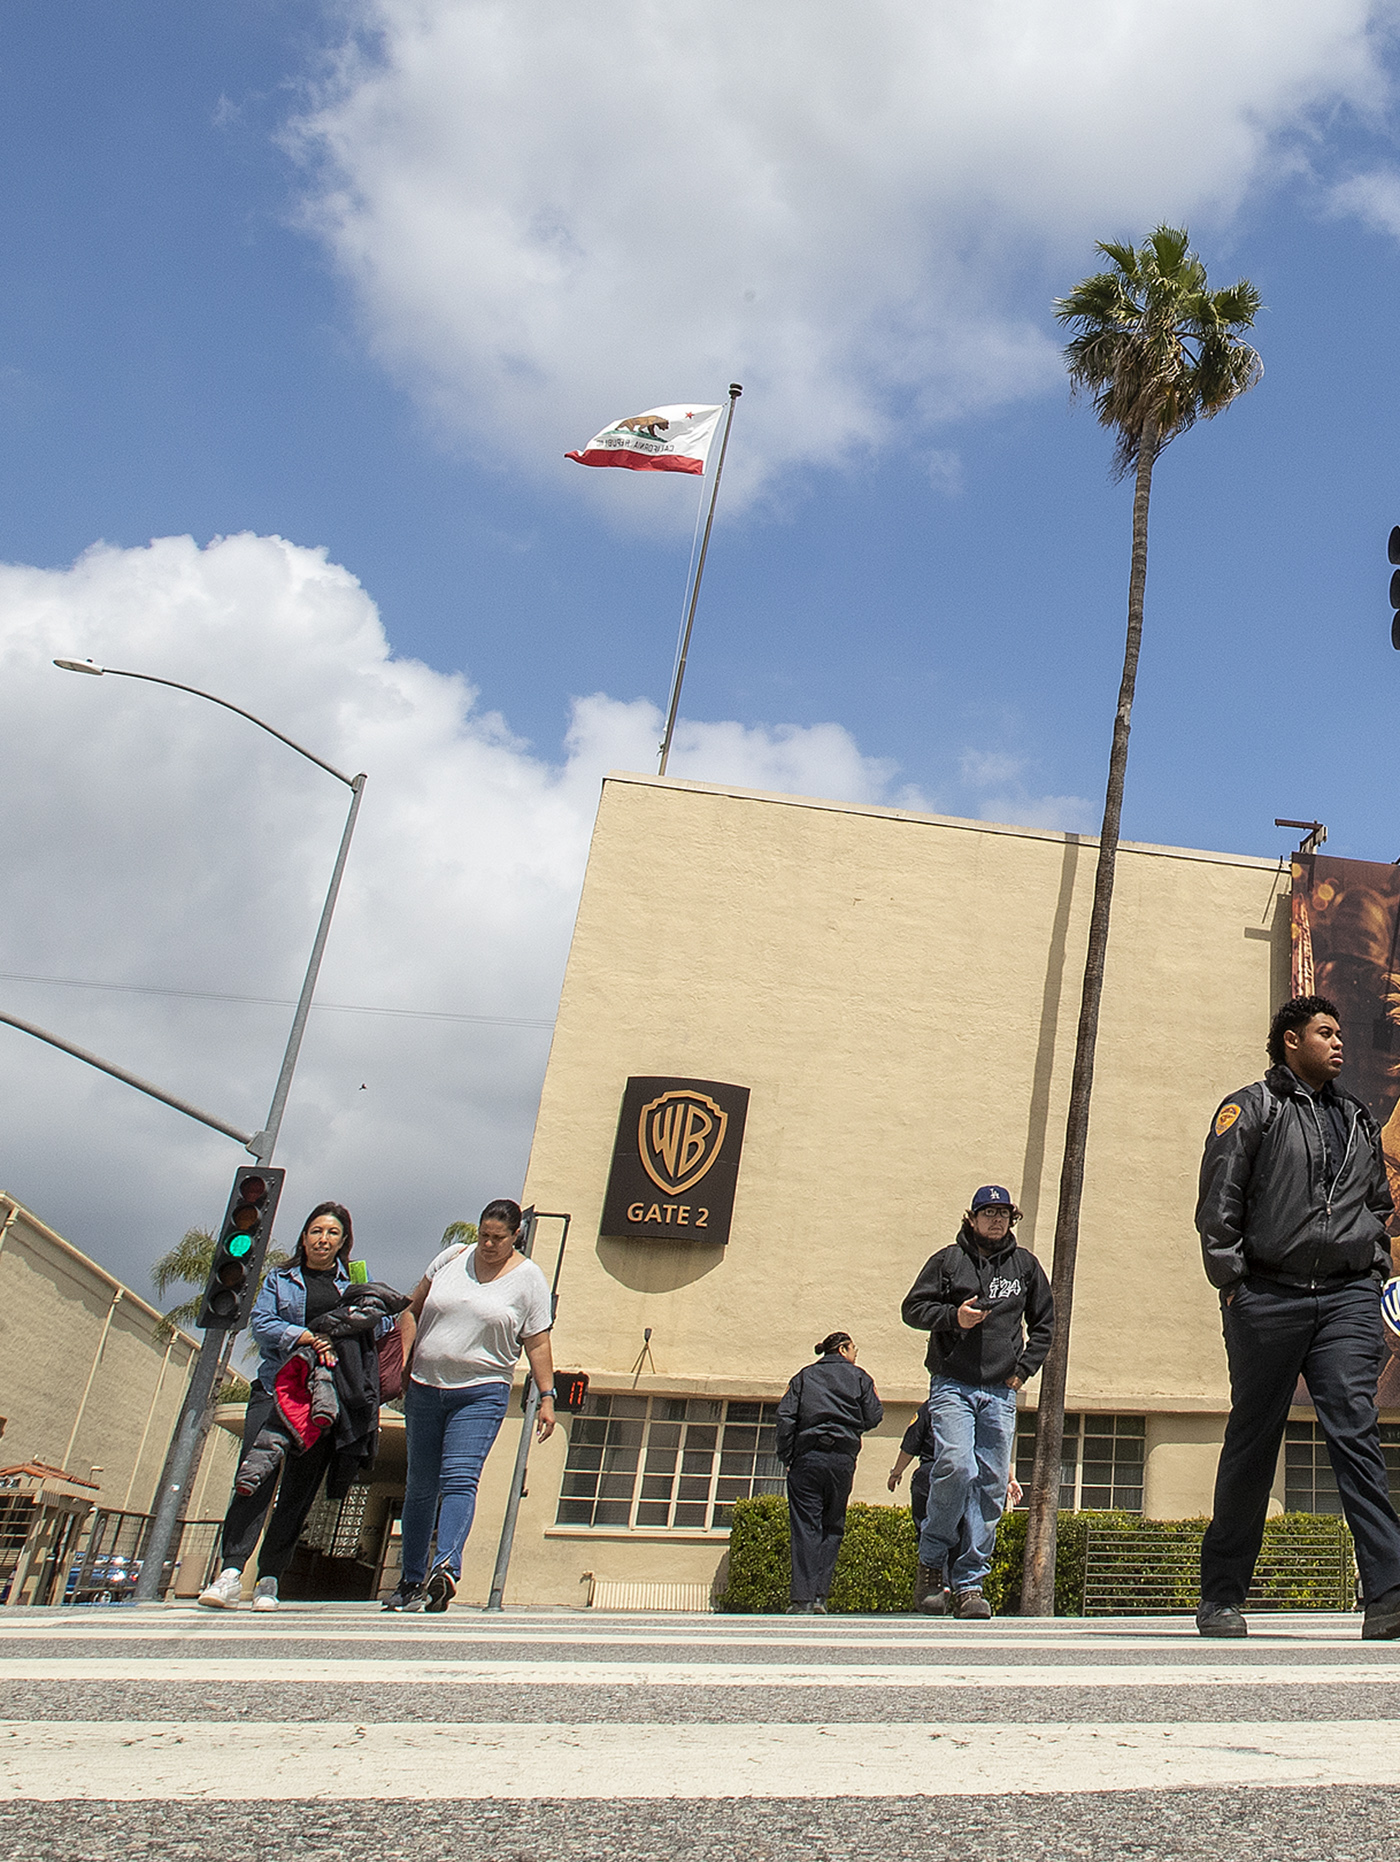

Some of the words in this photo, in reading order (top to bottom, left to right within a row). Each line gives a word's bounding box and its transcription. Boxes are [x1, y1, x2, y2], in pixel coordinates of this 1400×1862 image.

[651, 1102, 714, 1179] WB
[626, 1202, 691, 1226] GATE
[695, 1207, 710, 1227] 2
[569, 1381, 584, 1405] 17
